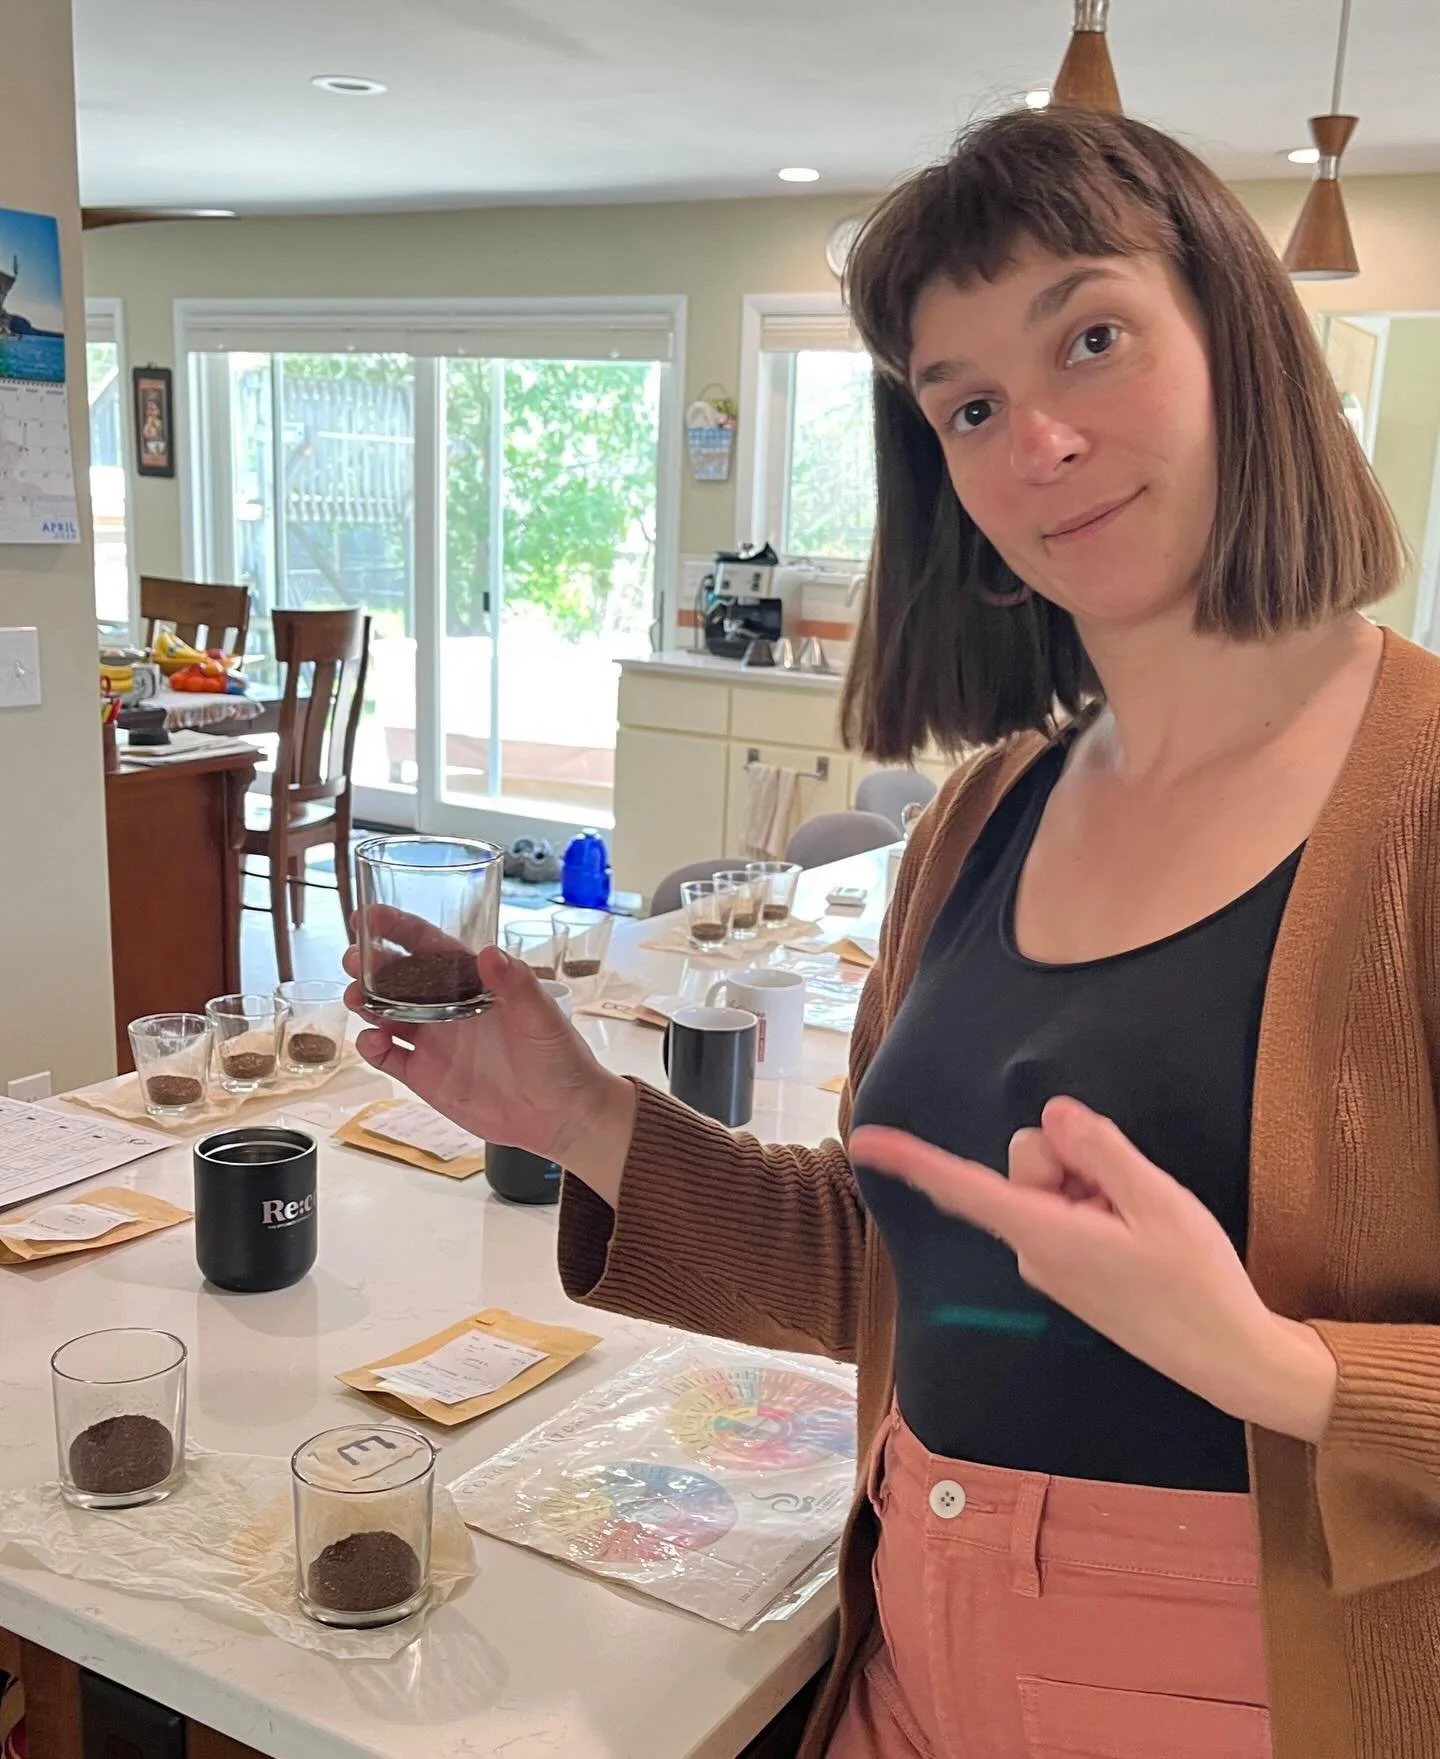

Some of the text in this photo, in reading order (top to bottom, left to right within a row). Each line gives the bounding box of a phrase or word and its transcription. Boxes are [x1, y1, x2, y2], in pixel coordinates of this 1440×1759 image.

[42, 521, 76, 533] APRIL
[262, 1192, 316, 1224] Re:c
[337, 1435, 397, 1466] E
